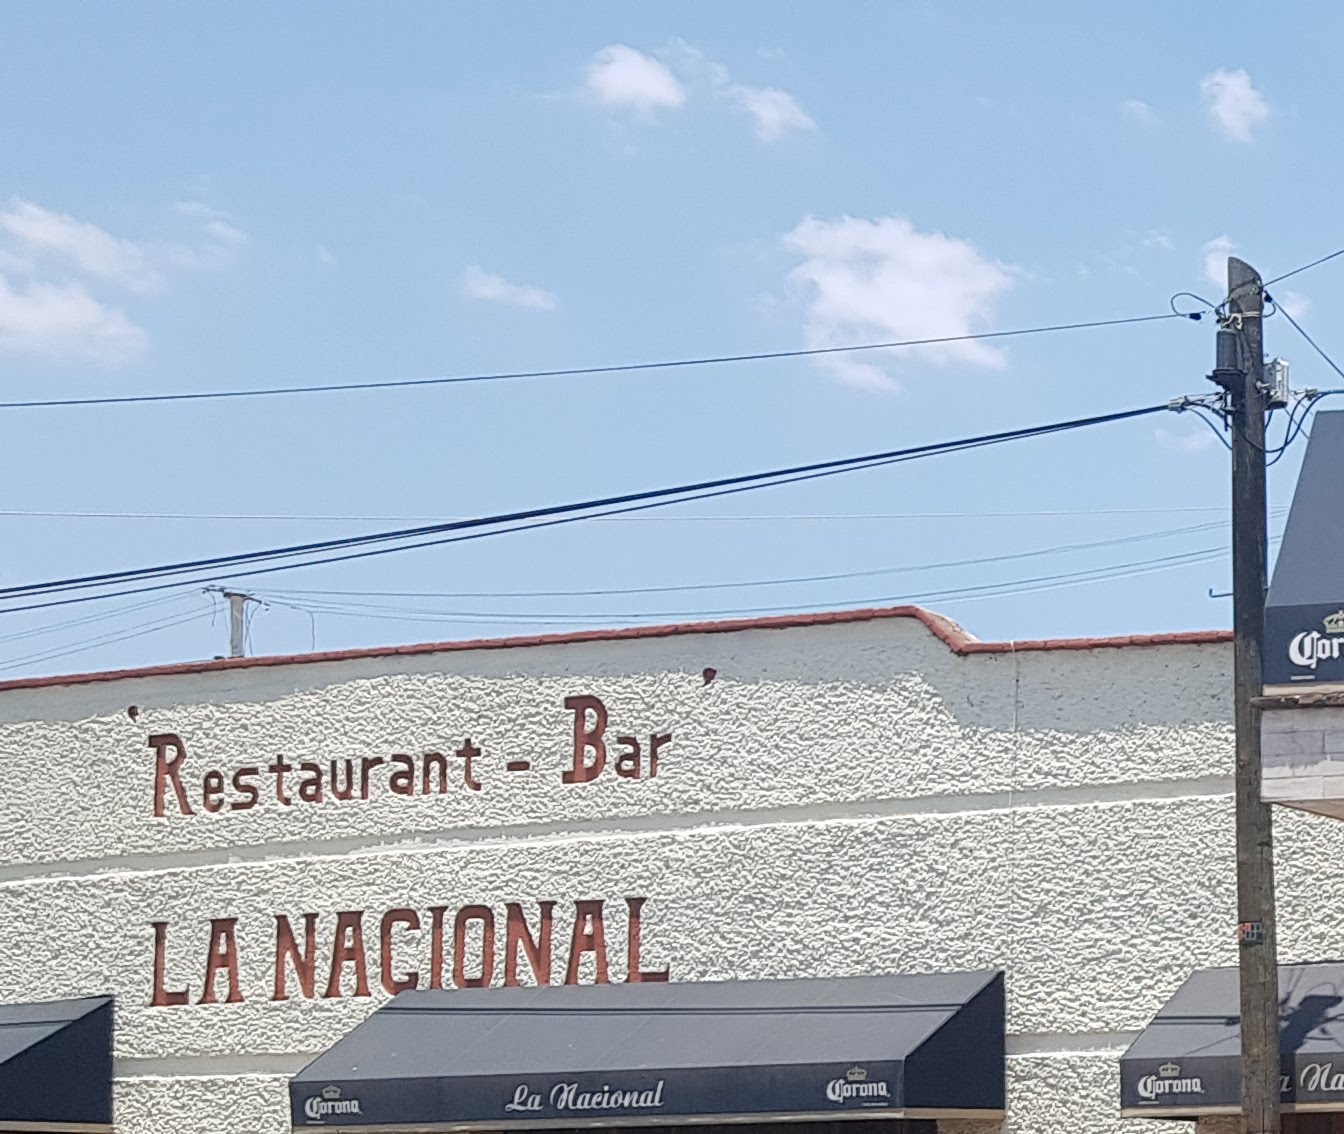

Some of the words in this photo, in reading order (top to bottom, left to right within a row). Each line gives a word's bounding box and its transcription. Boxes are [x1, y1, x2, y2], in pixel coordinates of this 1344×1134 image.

[148, 732, 483, 818] Restaurant
[562, 694, 672, 785] Bar
[150, 917, 245, 1008] LA
[272, 897, 670, 1002] NACIONAL
[504, 1084, 544, 1113] La
[549, 1079, 665, 1112] Nacional
[826, 1078, 888, 1104] Corona
[1137, 1074, 1203, 1100] Corona
[304, 1096, 360, 1120] Corona
